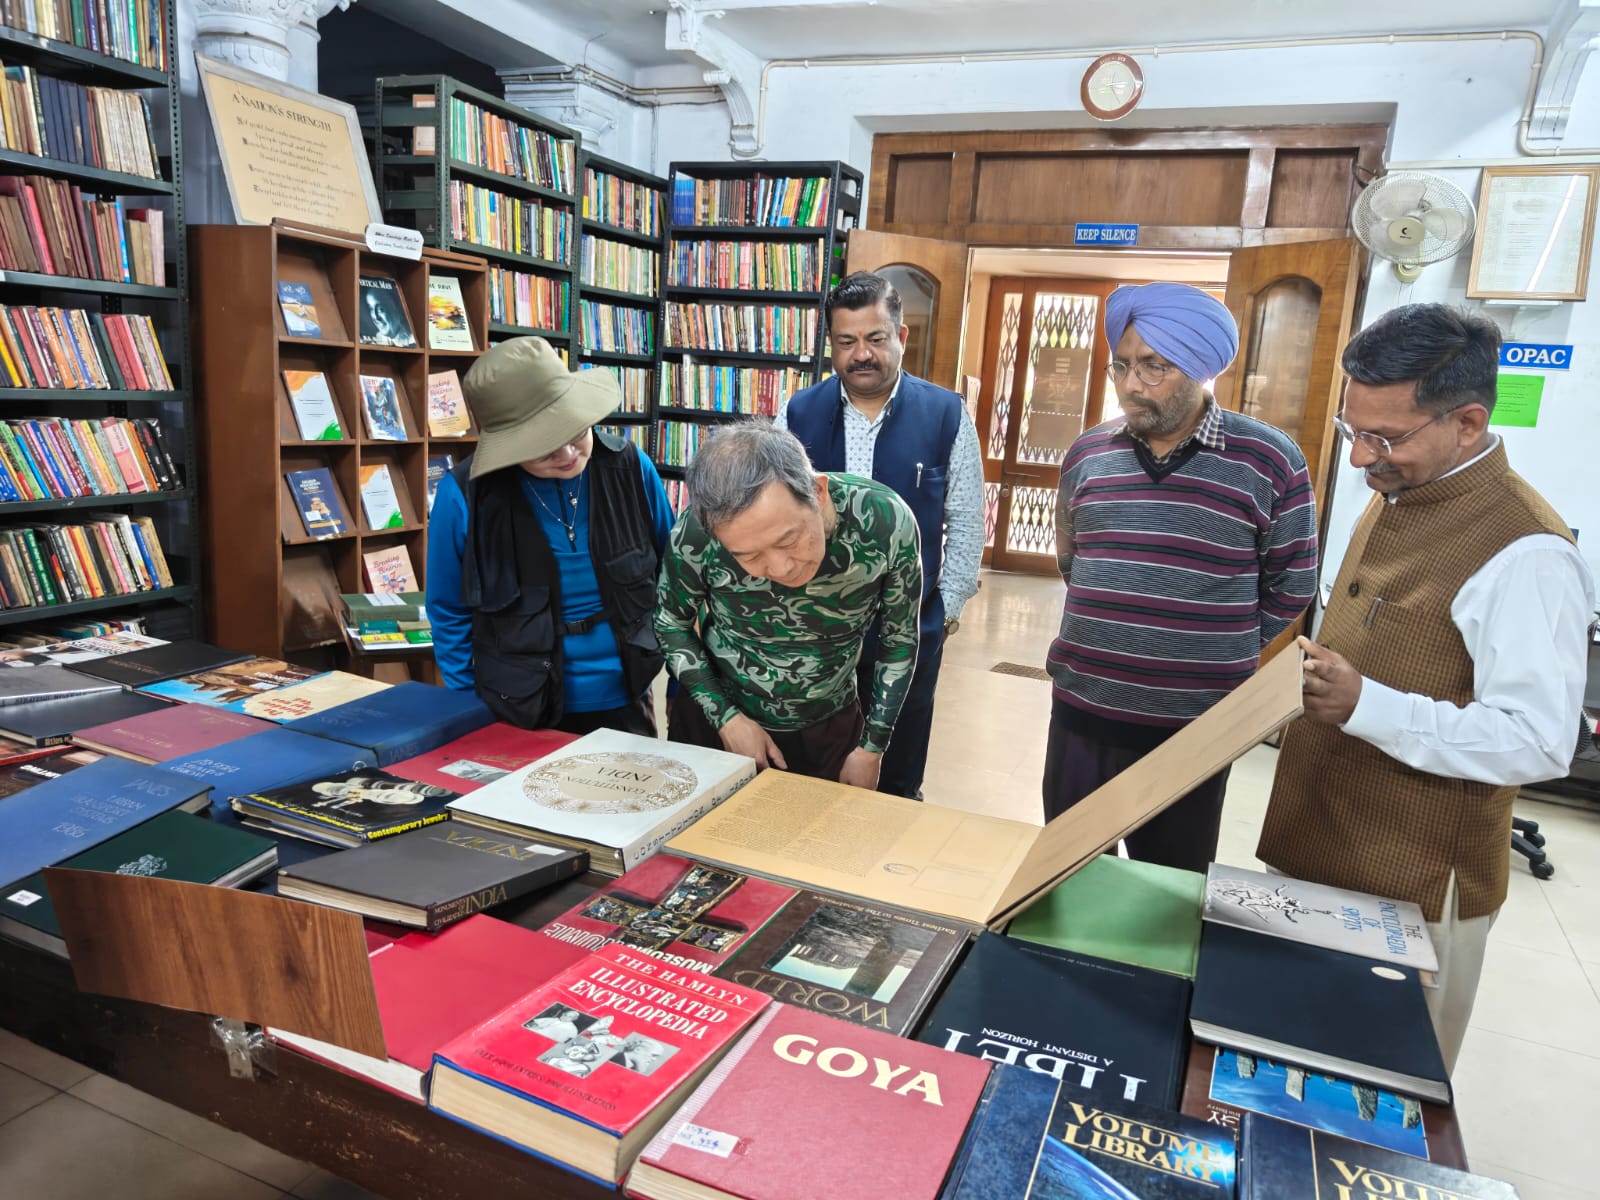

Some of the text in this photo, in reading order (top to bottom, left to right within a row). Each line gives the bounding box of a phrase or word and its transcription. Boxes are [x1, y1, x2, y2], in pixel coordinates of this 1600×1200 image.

[286, 110, 332, 132] STRENGTH
[1077, 228, 1136, 242] KEEP SILENCE
[1506, 347, 1567, 365] OPAC
[566, 776, 646, 795] CONSTITUTION
[598, 766, 653, 783] INDIA
[367, 813, 449, 839] Contemporary Jewelry
[465, 884, 508, 914] INDIA
[1361, 917, 1381, 930] OF
[1378, 900, 1409, 956] ENCYCLOPAEDIA
[1404, 924, 1423, 940] THE
[589, 967, 729, 1024] ILLUSTRATED
[616, 953, 748, 1006] THE HAMLYN
[568, 980, 709, 1040] ENCYCLOPEDIA
[732, 969, 892, 1029] WORLD
[980, 1028, 1115, 1067] A DISTANT HORIZON
[772, 1033, 944, 1107] GOYA
[1068, 1101, 1222, 1165] VOLUME
[1061, 1122, 1215, 1182] LIBRARY
